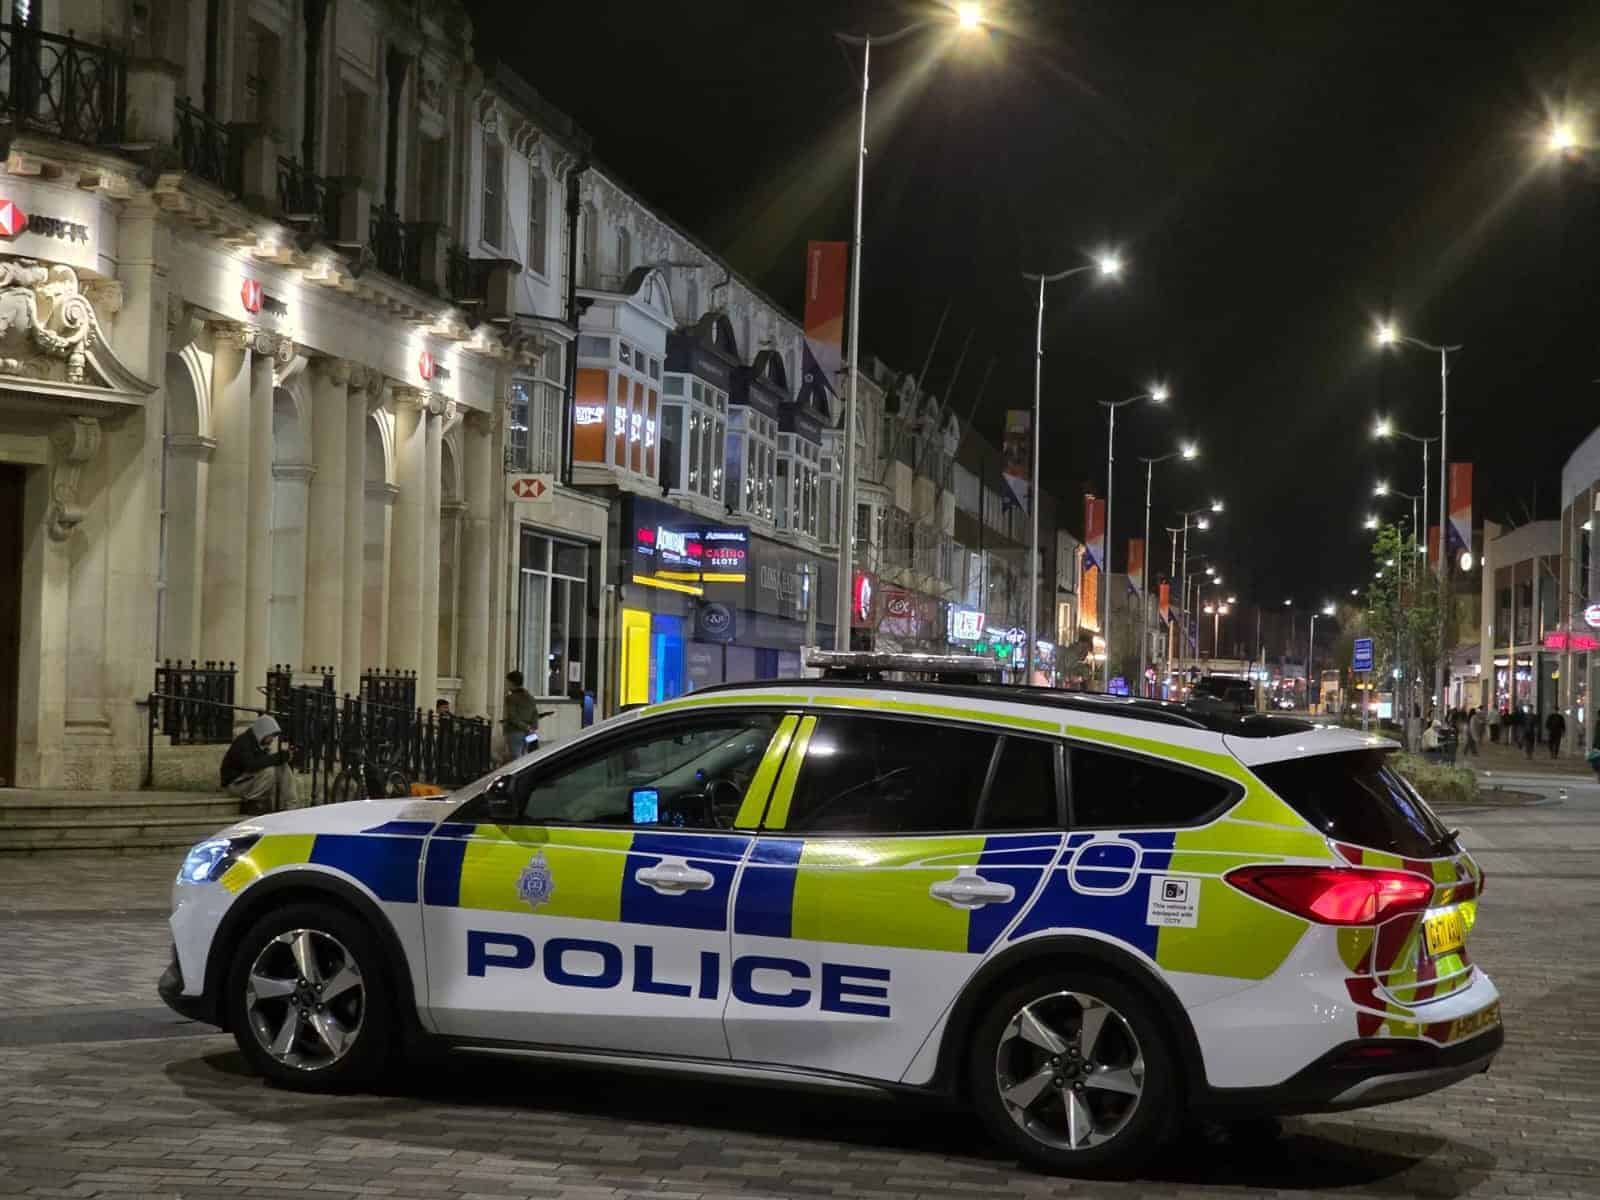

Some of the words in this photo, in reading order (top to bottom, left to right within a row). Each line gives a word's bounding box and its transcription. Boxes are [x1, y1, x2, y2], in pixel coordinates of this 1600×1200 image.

[705, 549, 745, 559] CASINO
[711, 558, 739, 566] SLOTS
[466, 930, 891, 1018] POLICE
